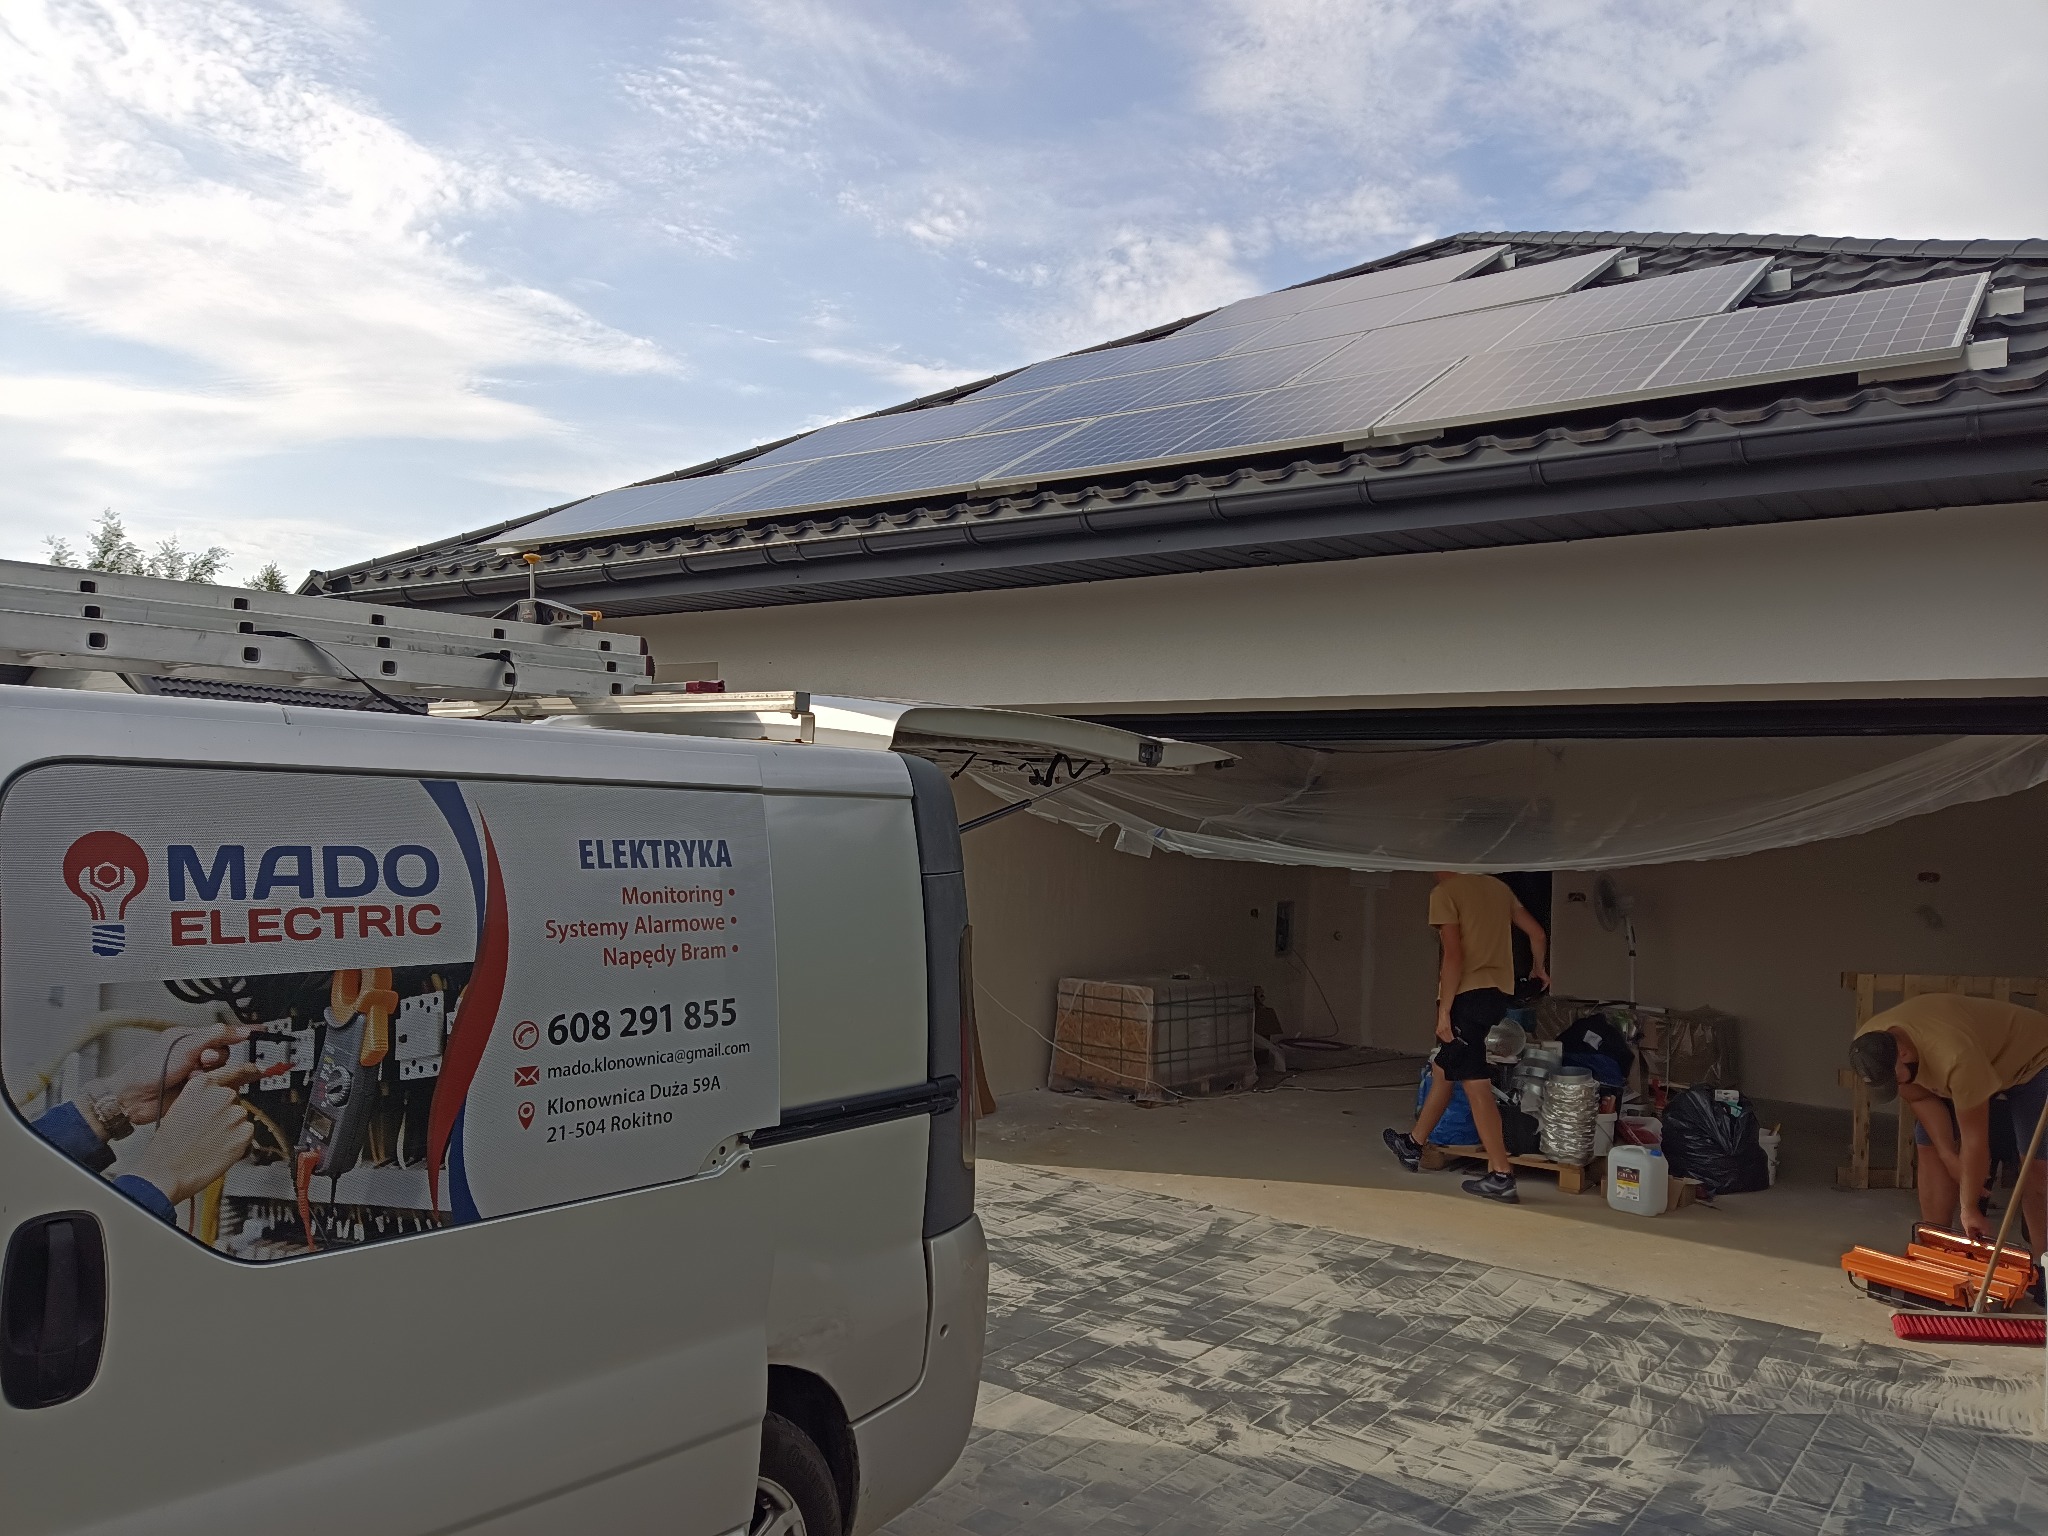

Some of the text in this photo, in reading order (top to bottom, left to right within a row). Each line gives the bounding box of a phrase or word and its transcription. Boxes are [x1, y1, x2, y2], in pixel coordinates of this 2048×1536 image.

[579, 839, 733, 870] ELEKTRYKA
[167, 844, 440, 902] MADO
[622, 885, 724, 907] Monitoring
[170, 904, 443, 947] ELECTRIC
[545, 915, 726, 944] Systemy Alarmowe
[603, 943, 727, 970] Napędy Bram
[547, 998, 738, 1046] 608 291 855
[547, 1041, 751, 1080] mado.klonownica@gmail.com
[547, 1075, 721, 1116] Klonownica Duża 59A
[546, 1110, 674, 1144] 21-504 Rokitno
